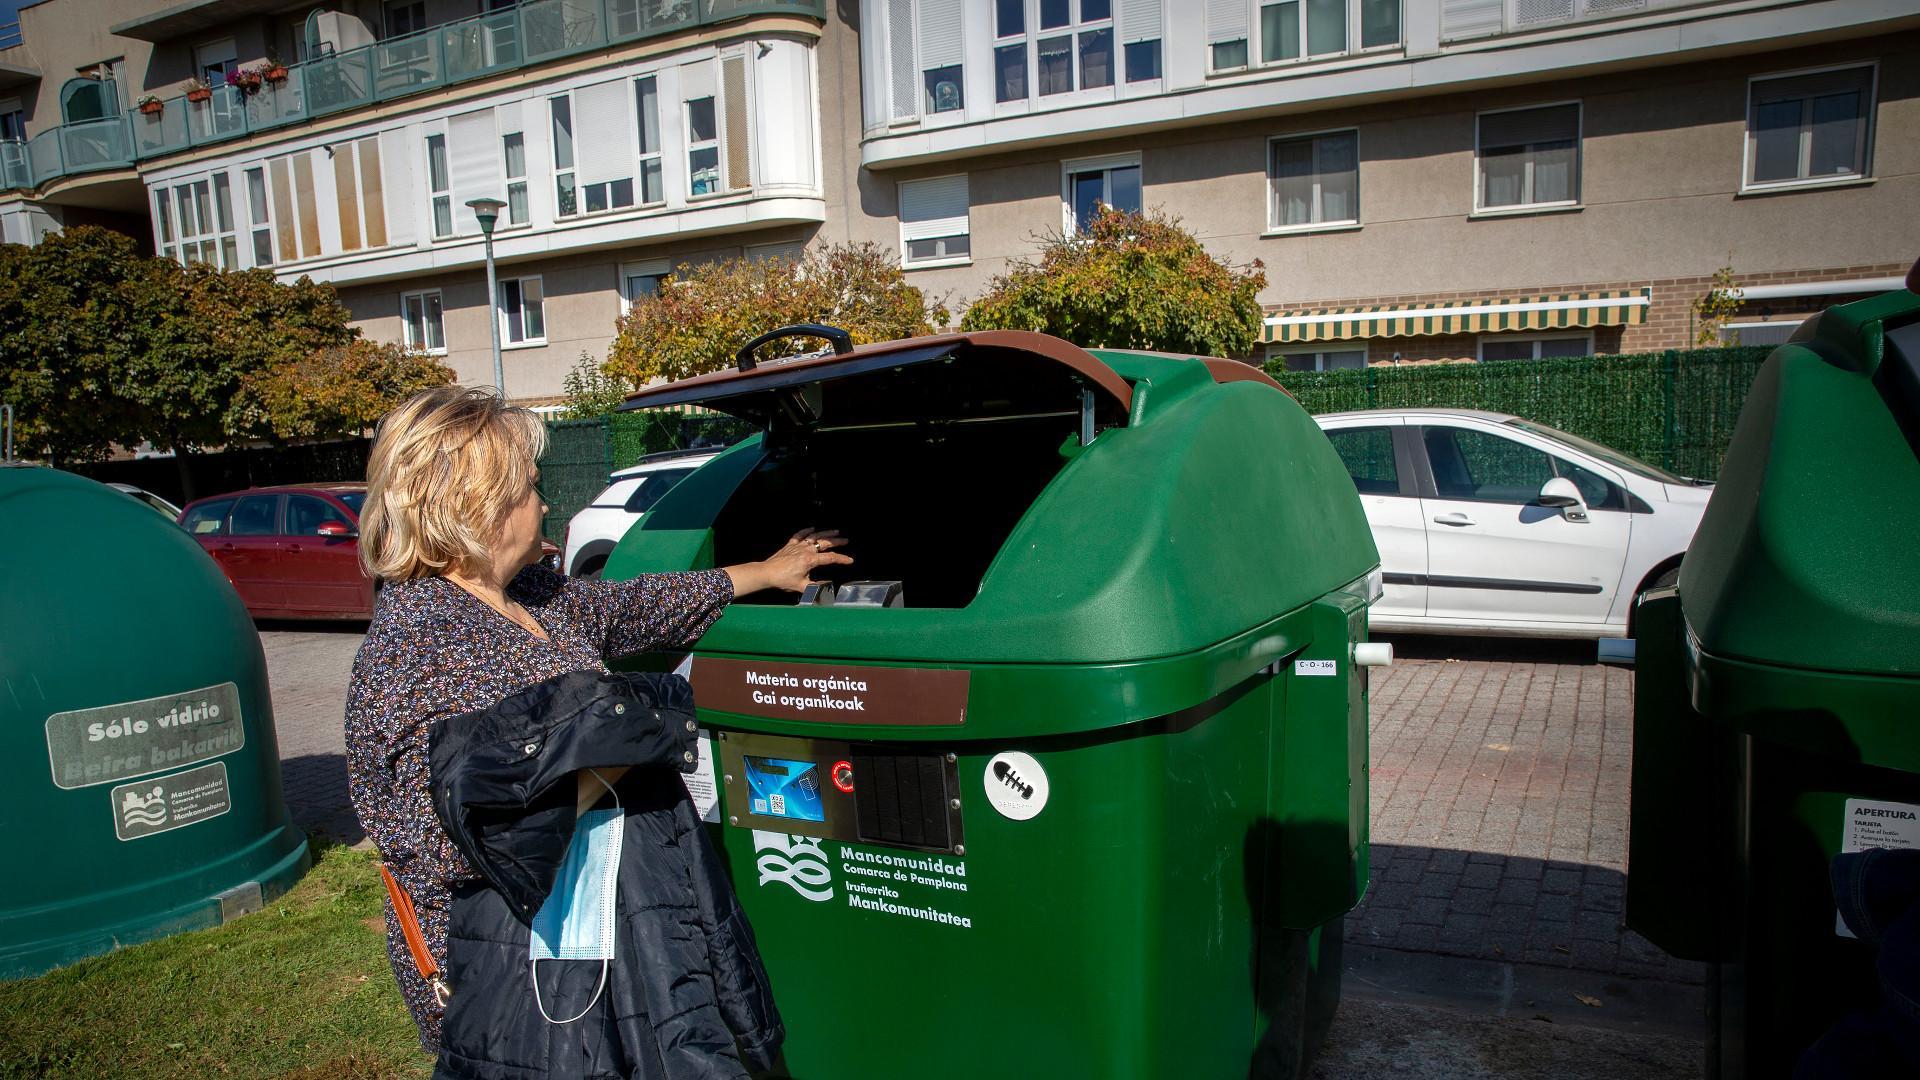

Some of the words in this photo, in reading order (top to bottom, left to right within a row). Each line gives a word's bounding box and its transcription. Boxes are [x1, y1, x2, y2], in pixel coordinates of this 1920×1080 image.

[746, 670, 799, 688] Materia
[803, 675, 867, 693] orgánica
[752, 690, 777, 705] Gai
[780, 694, 865, 711] organikoak
[87, 717, 149, 742] Sólo
[156, 701, 220, 729] vidrio
[65, 754, 142, 780] Beira
[151, 727, 240, 766] bakarrik
[171, 778, 223, 799] Mancomunidad
[174, 802, 226, 821] Mankomunitatea
[1854, 807, 1917, 821] APERTURA
[1854, 820, 1882, 828] TARJETA
[840, 846, 966, 877] Mancomunidad
[843, 862, 891, 879] Comarca
[893, 869, 908, 882] de
[910, 872, 968, 892] Pamplona
[845, 880, 899, 898] Iruñerriko
[848, 893, 972, 928] Mankomunitatea
